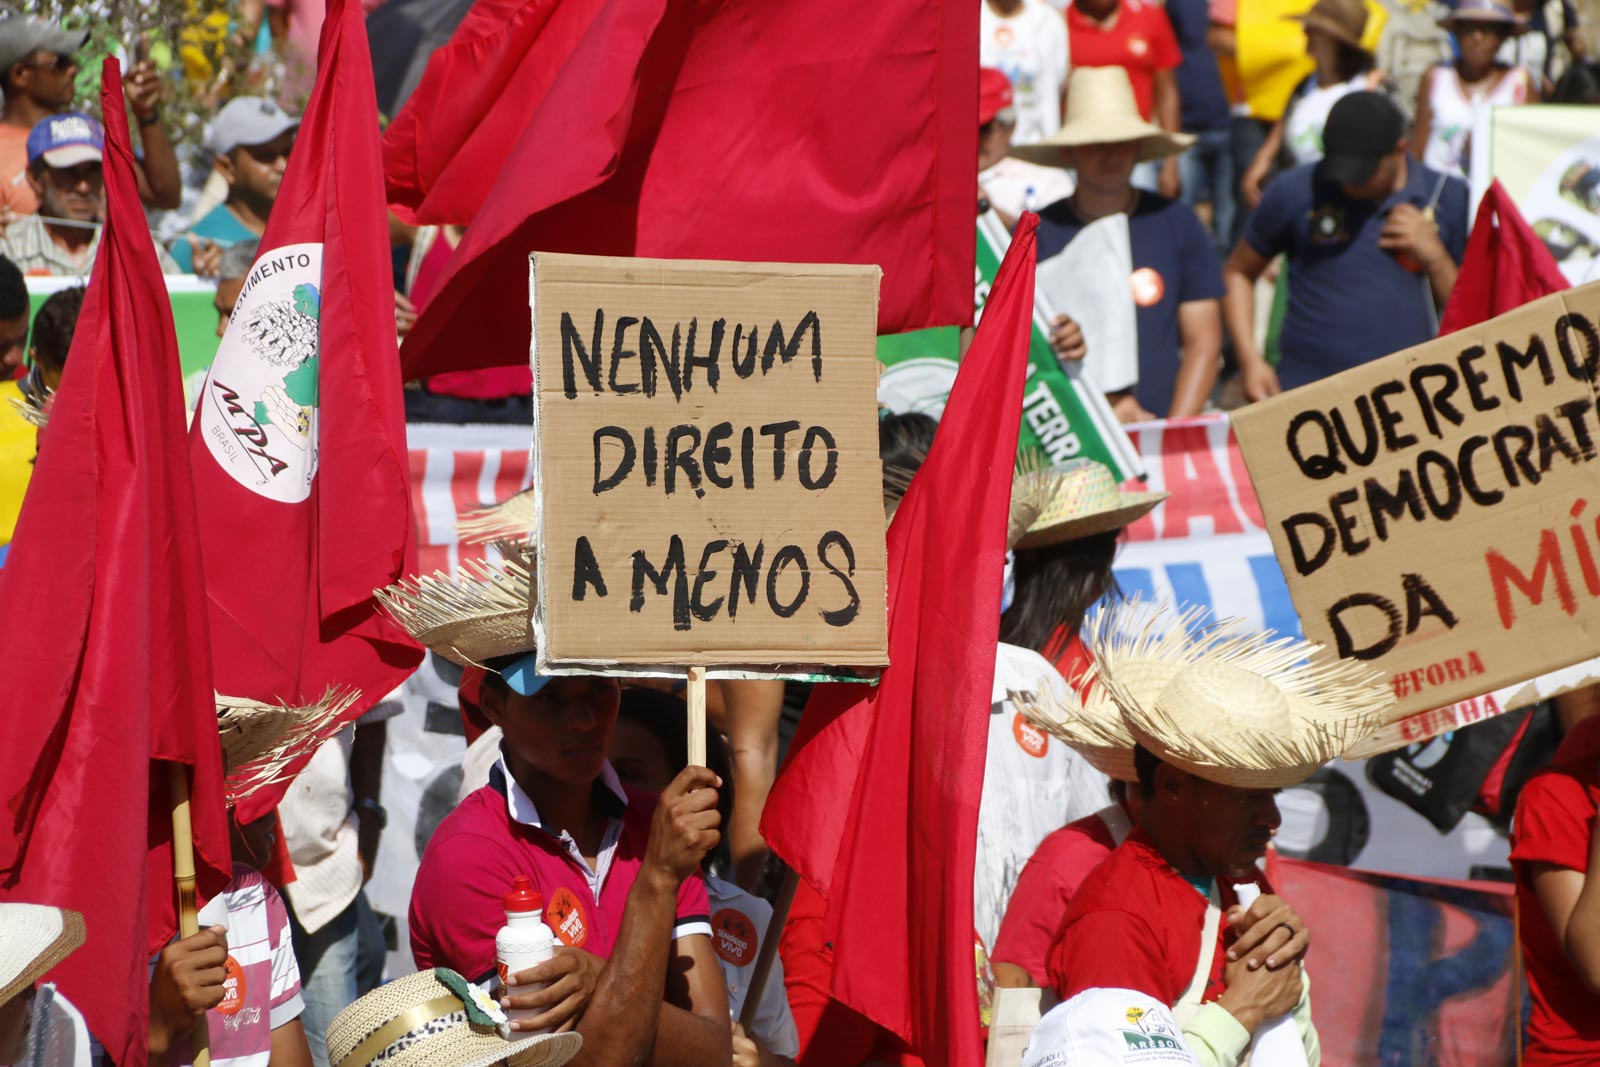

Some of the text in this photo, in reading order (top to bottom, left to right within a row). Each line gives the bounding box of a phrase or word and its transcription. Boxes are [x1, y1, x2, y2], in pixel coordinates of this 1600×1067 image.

[560, 308, 822, 403] NENHUM
[1286, 312, 1600, 480] QUEREMO
[211, 425, 239, 464] BRASIL
[593, 420, 839, 499] DIREITO
[1022, 380, 1082, 465] TERR
[1281, 397, 1600, 577] DEMOCRAT
[572, 530, 861, 631] A MENOS
[1327, 573, 1459, 660] DA
[1484, 498, 1600, 630] MÍ
[1391, 650, 1486, 699] #FORA
[1400, 694, 1501, 741] CUNHA
